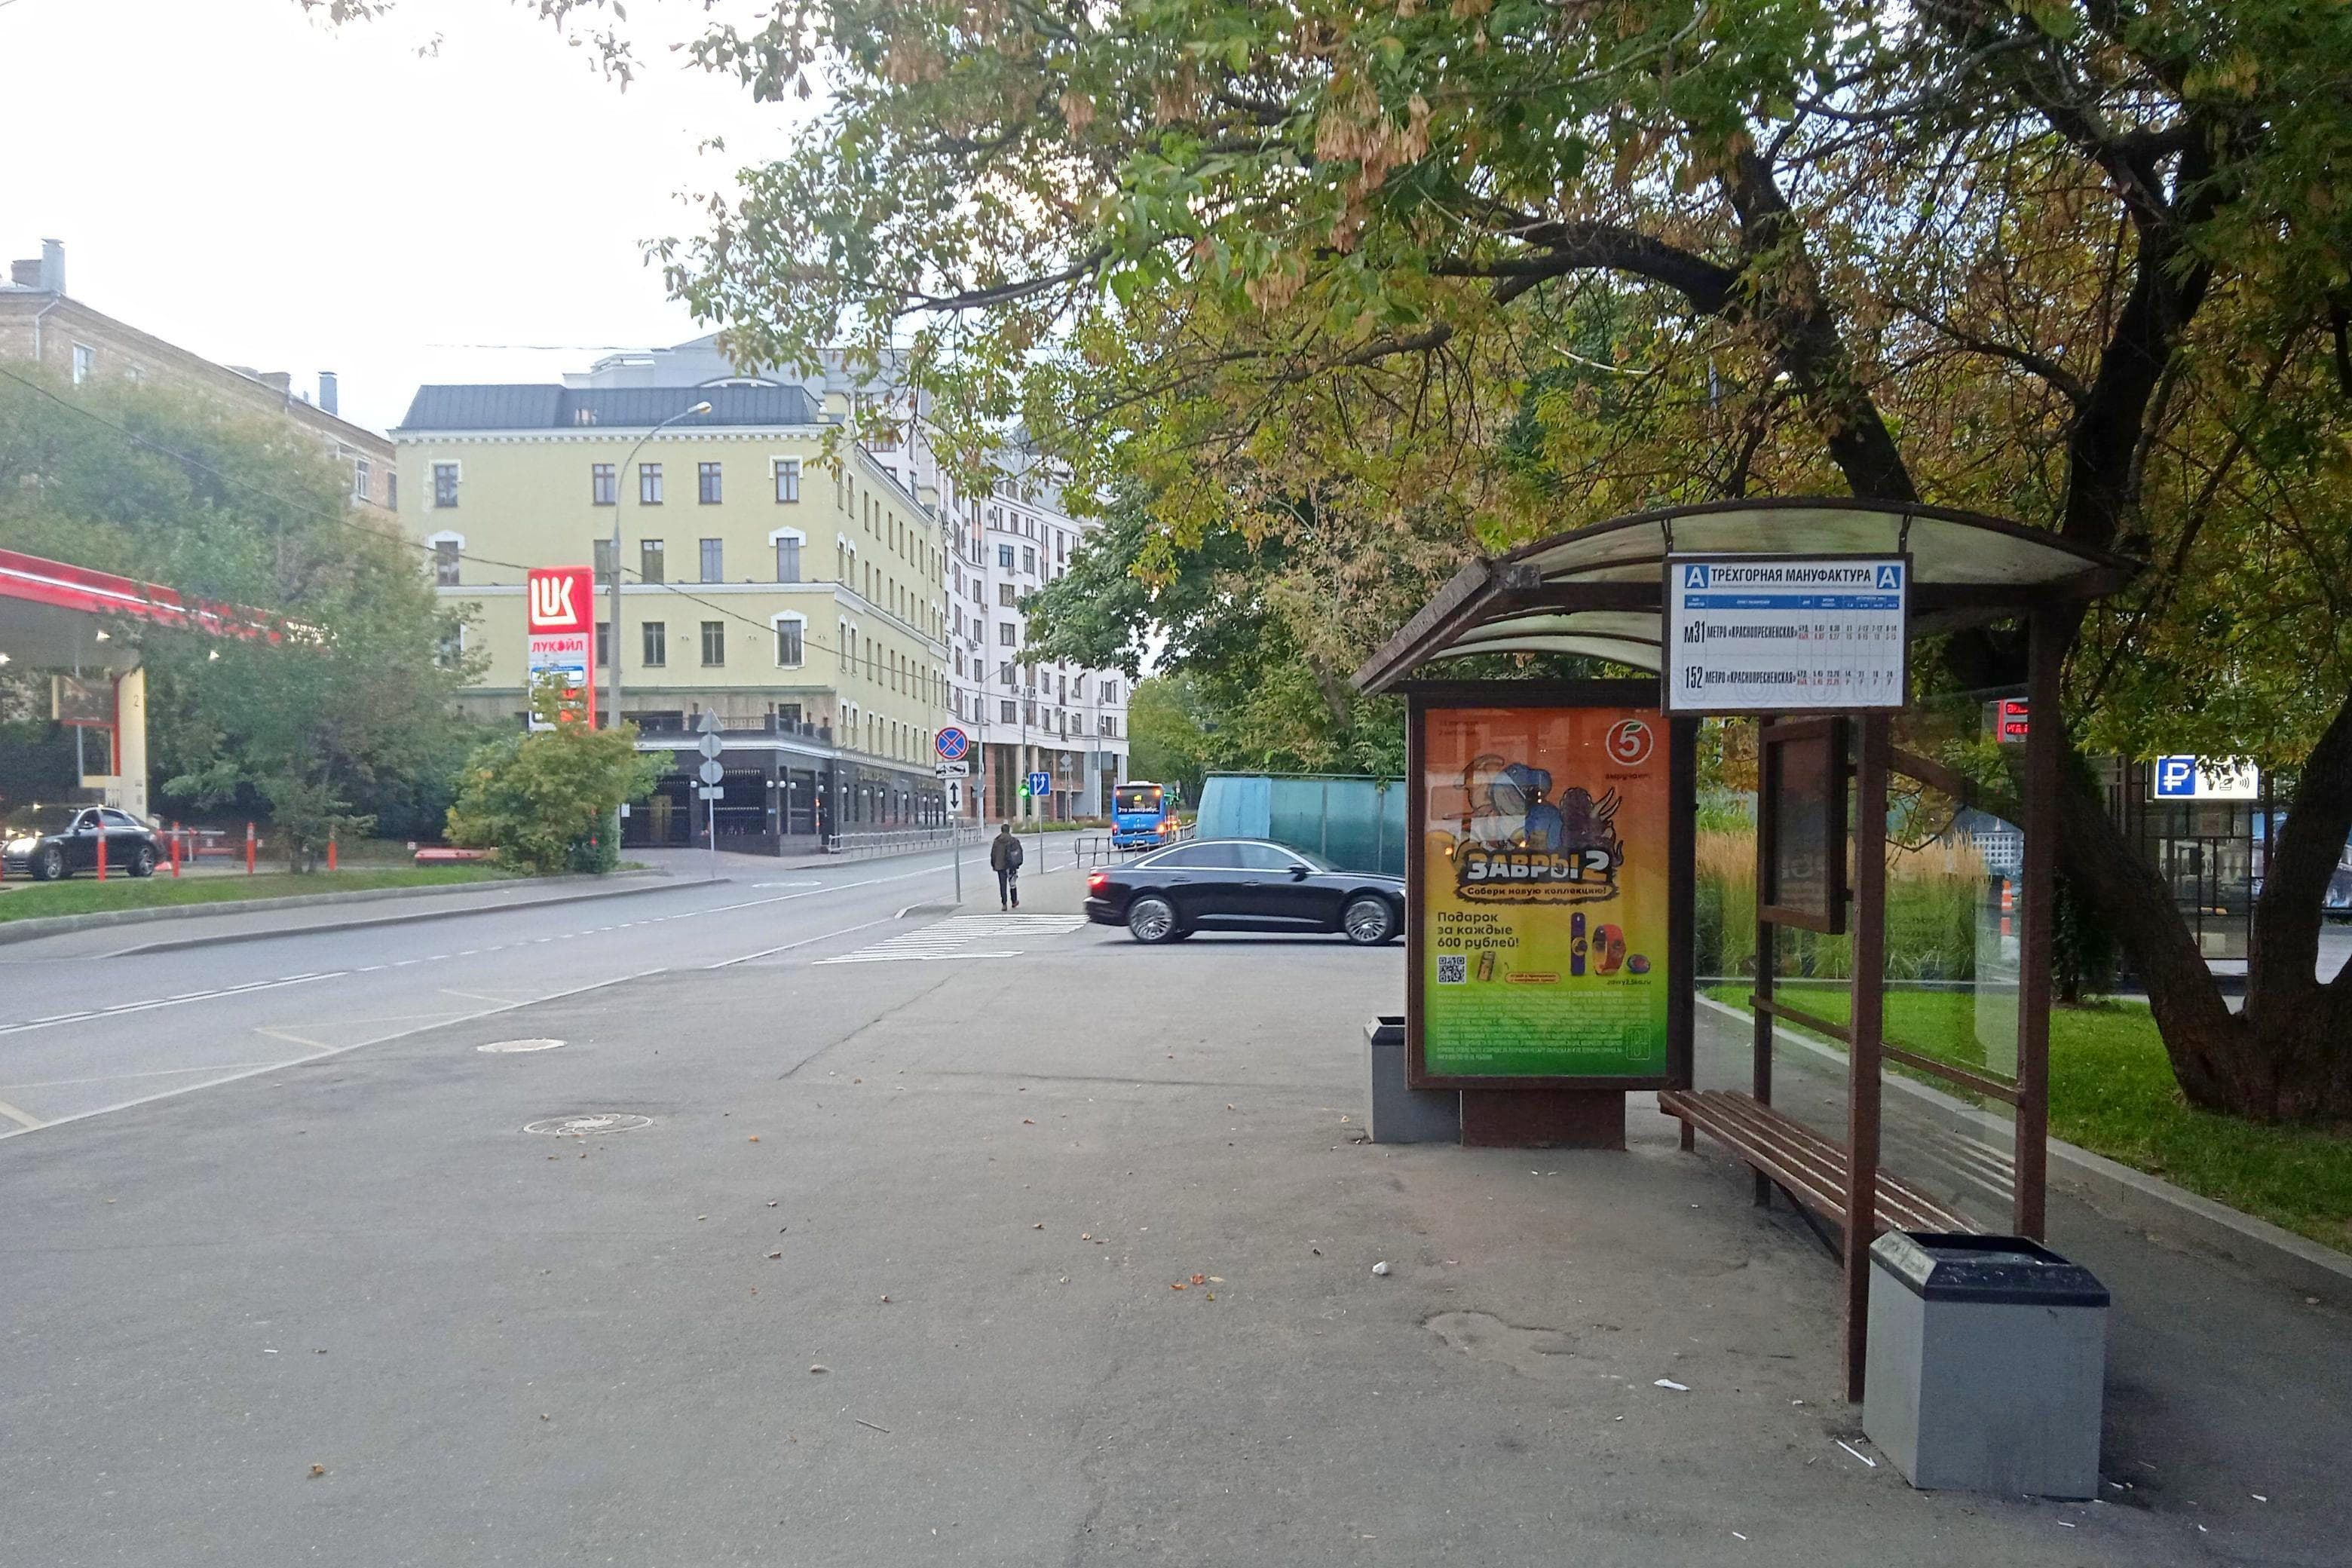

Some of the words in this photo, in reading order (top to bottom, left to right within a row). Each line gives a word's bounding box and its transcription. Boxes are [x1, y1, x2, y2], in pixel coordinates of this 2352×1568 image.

[1711, 567, 1782, 583] ТРЁХГОРНАЯ
[1786, 568, 1871, 583] МАНУФАКТУРА
[1684, 620, 1705, 643] м31
[1707, 626, 1727, 638] МЕТРО
[531, 639, 583, 653] ЛУКОЙЛ
[1685, 666, 1703, 688] 152
[1705, 671, 1726, 683] МЕТРО
[1466, 853, 1579, 880] ЗАВРЫ
[1582, 850, 1610, 881] 2
[1467, 886, 1505, 896] Собери
[1508, 887, 1542, 898] новую
[1545, 886, 1606, 898] коллекцию!
[1438, 911, 1499, 924] Подарок
[1438, 926, 1453, 935] за
[1457, 924, 1513, 935] каждые
[1438, 937, 1461, 948] 600
[1465, 937, 1519, 950] рублей!
